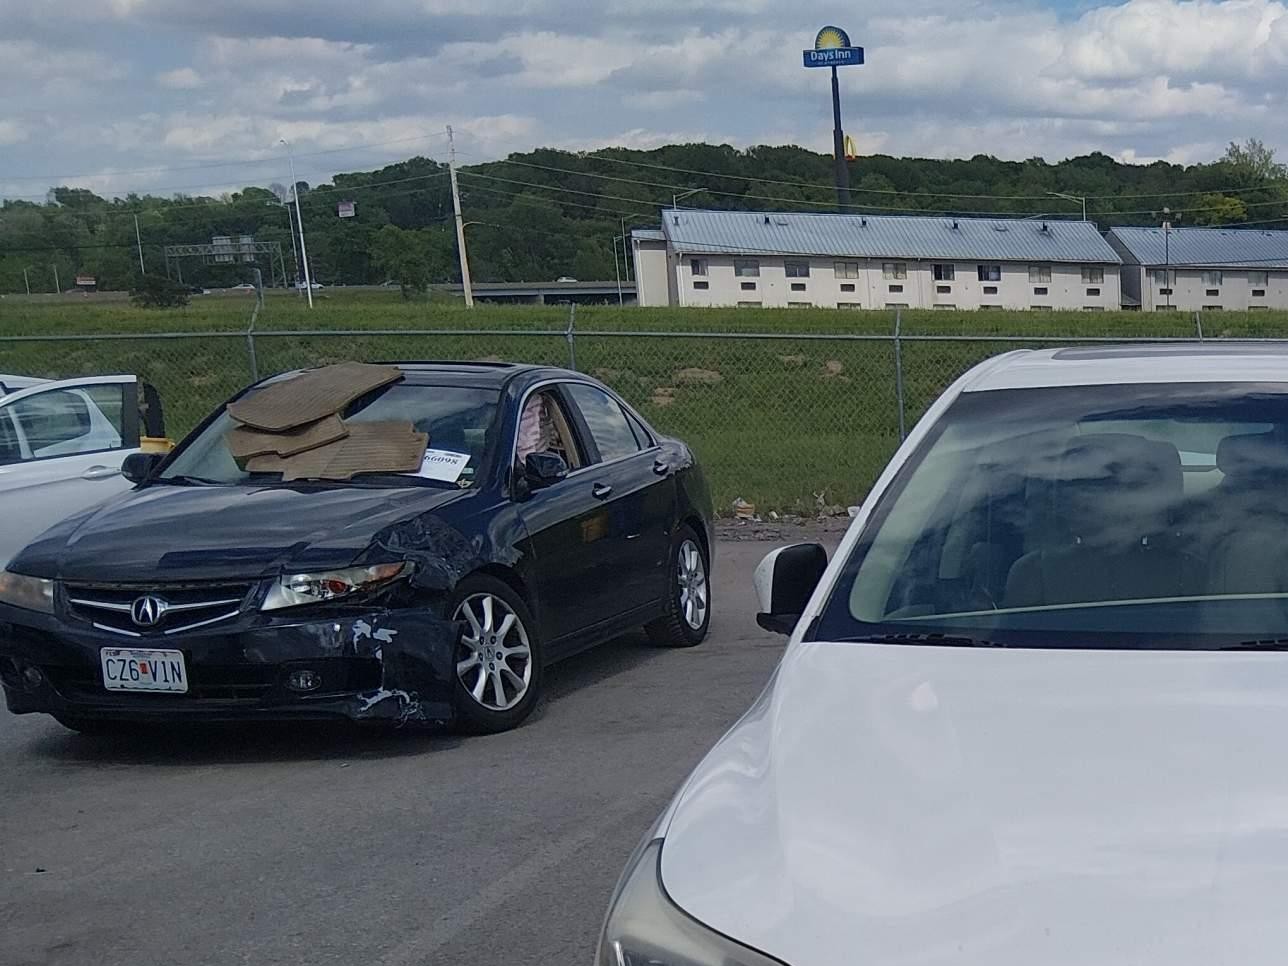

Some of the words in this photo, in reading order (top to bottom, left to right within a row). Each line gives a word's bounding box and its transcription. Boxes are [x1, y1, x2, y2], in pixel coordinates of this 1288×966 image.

[811, 50, 834, 61] Days
[835, 49, 851, 59] Inn
[105, 658, 140, 682] CZ6
